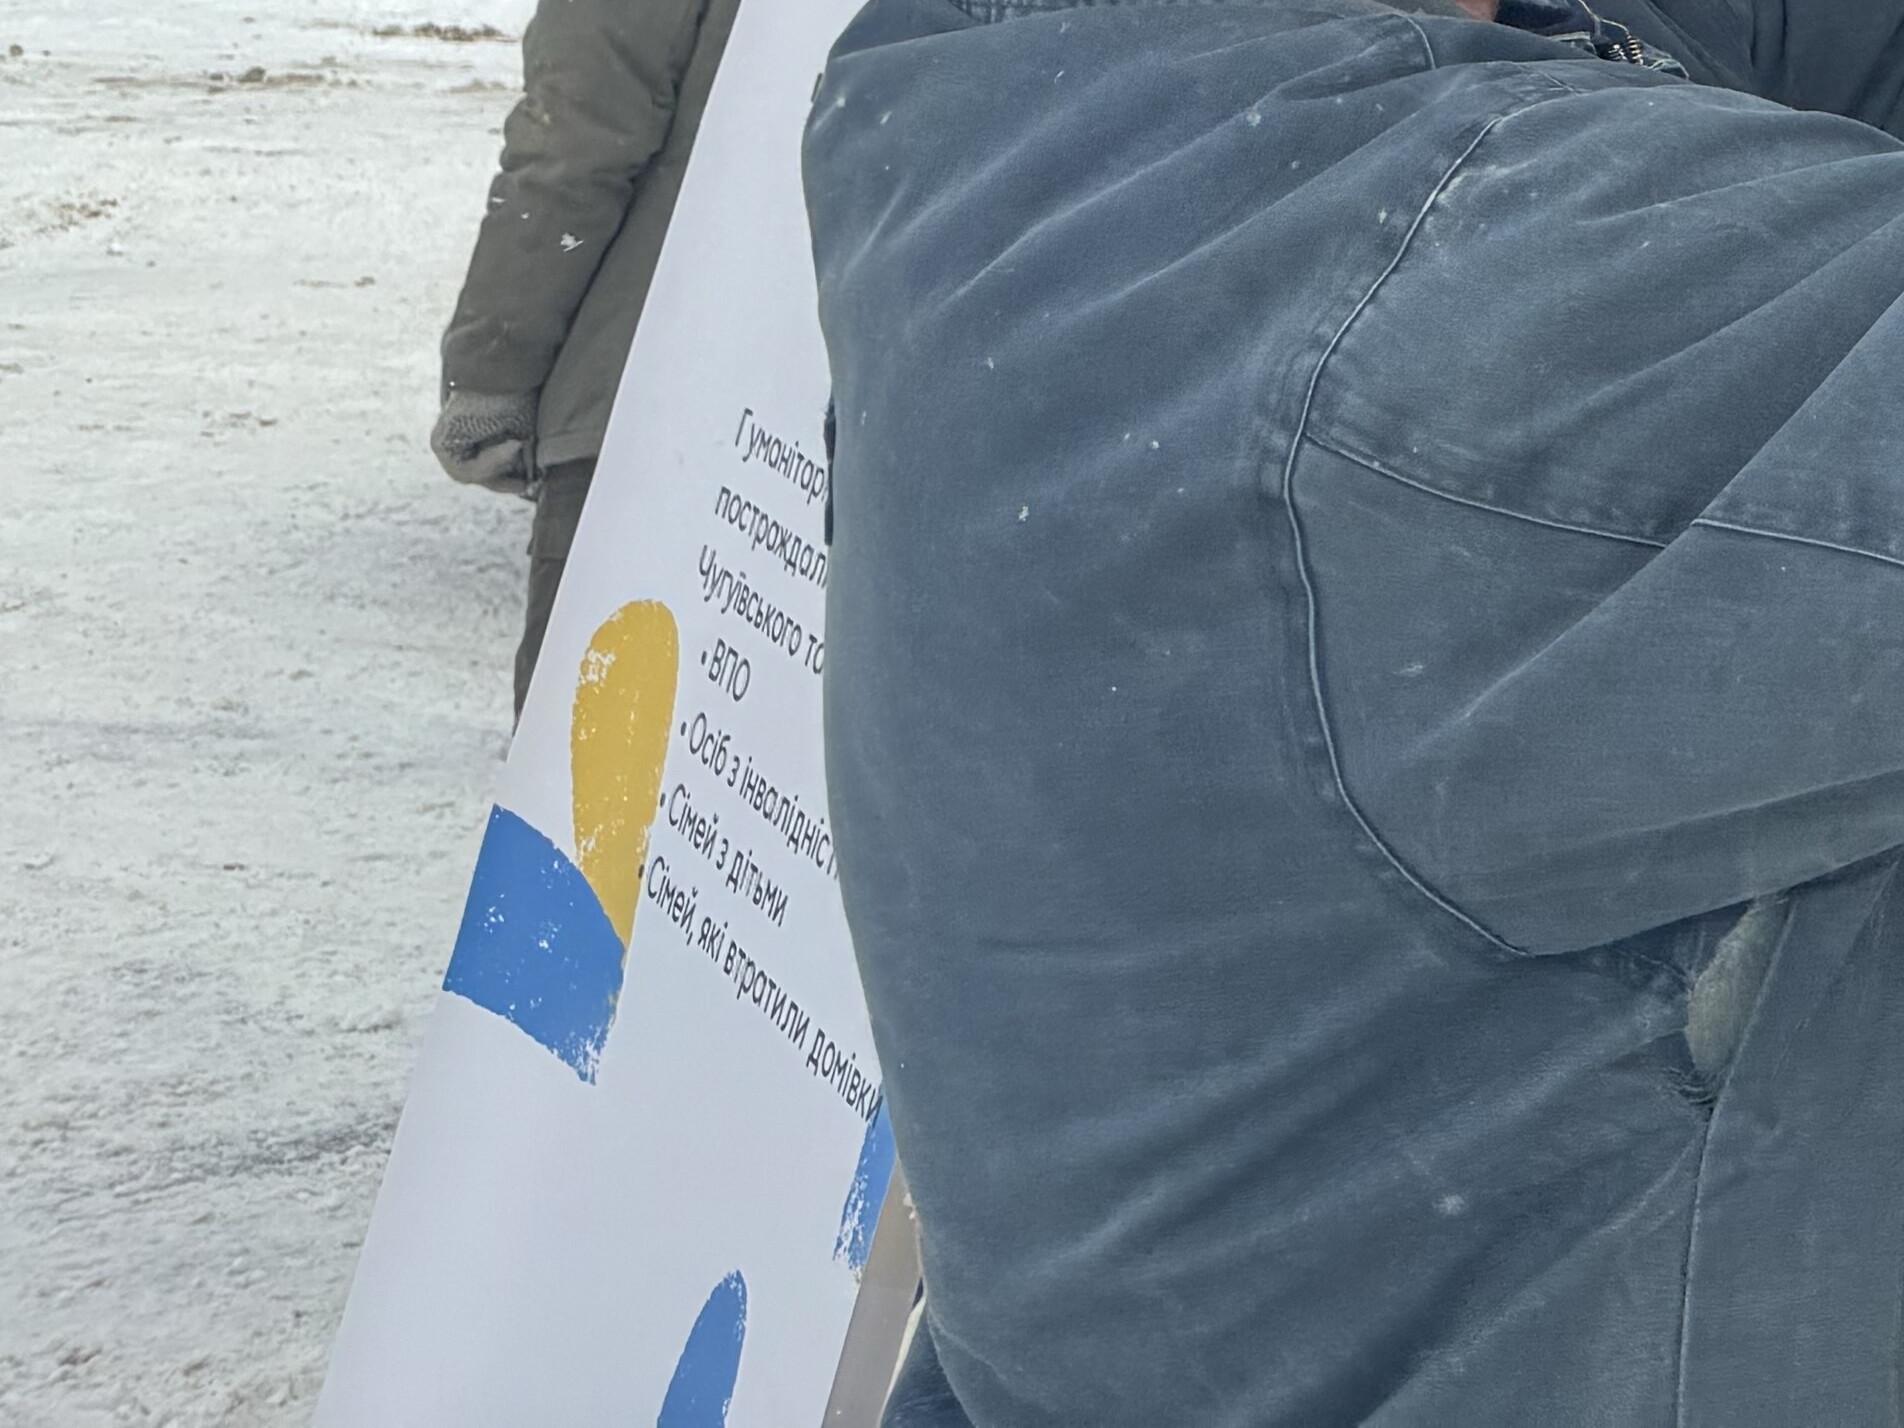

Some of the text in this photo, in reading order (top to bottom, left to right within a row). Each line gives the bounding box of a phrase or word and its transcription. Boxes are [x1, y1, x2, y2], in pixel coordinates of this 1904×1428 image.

[735, 408, 829, 505] Гуманітар
[714, 486, 826, 588] постраждал
[699, 545, 802, 656] Чугуївського
[708, 638, 751, 701] ВПО
[689, 711, 731, 775] Осіб
[727, 761, 743, 788] з
[668, 783, 788, 927] Сімей з дітьми
[647, 855, 885, 1125] Сімей, які втратили домівки
